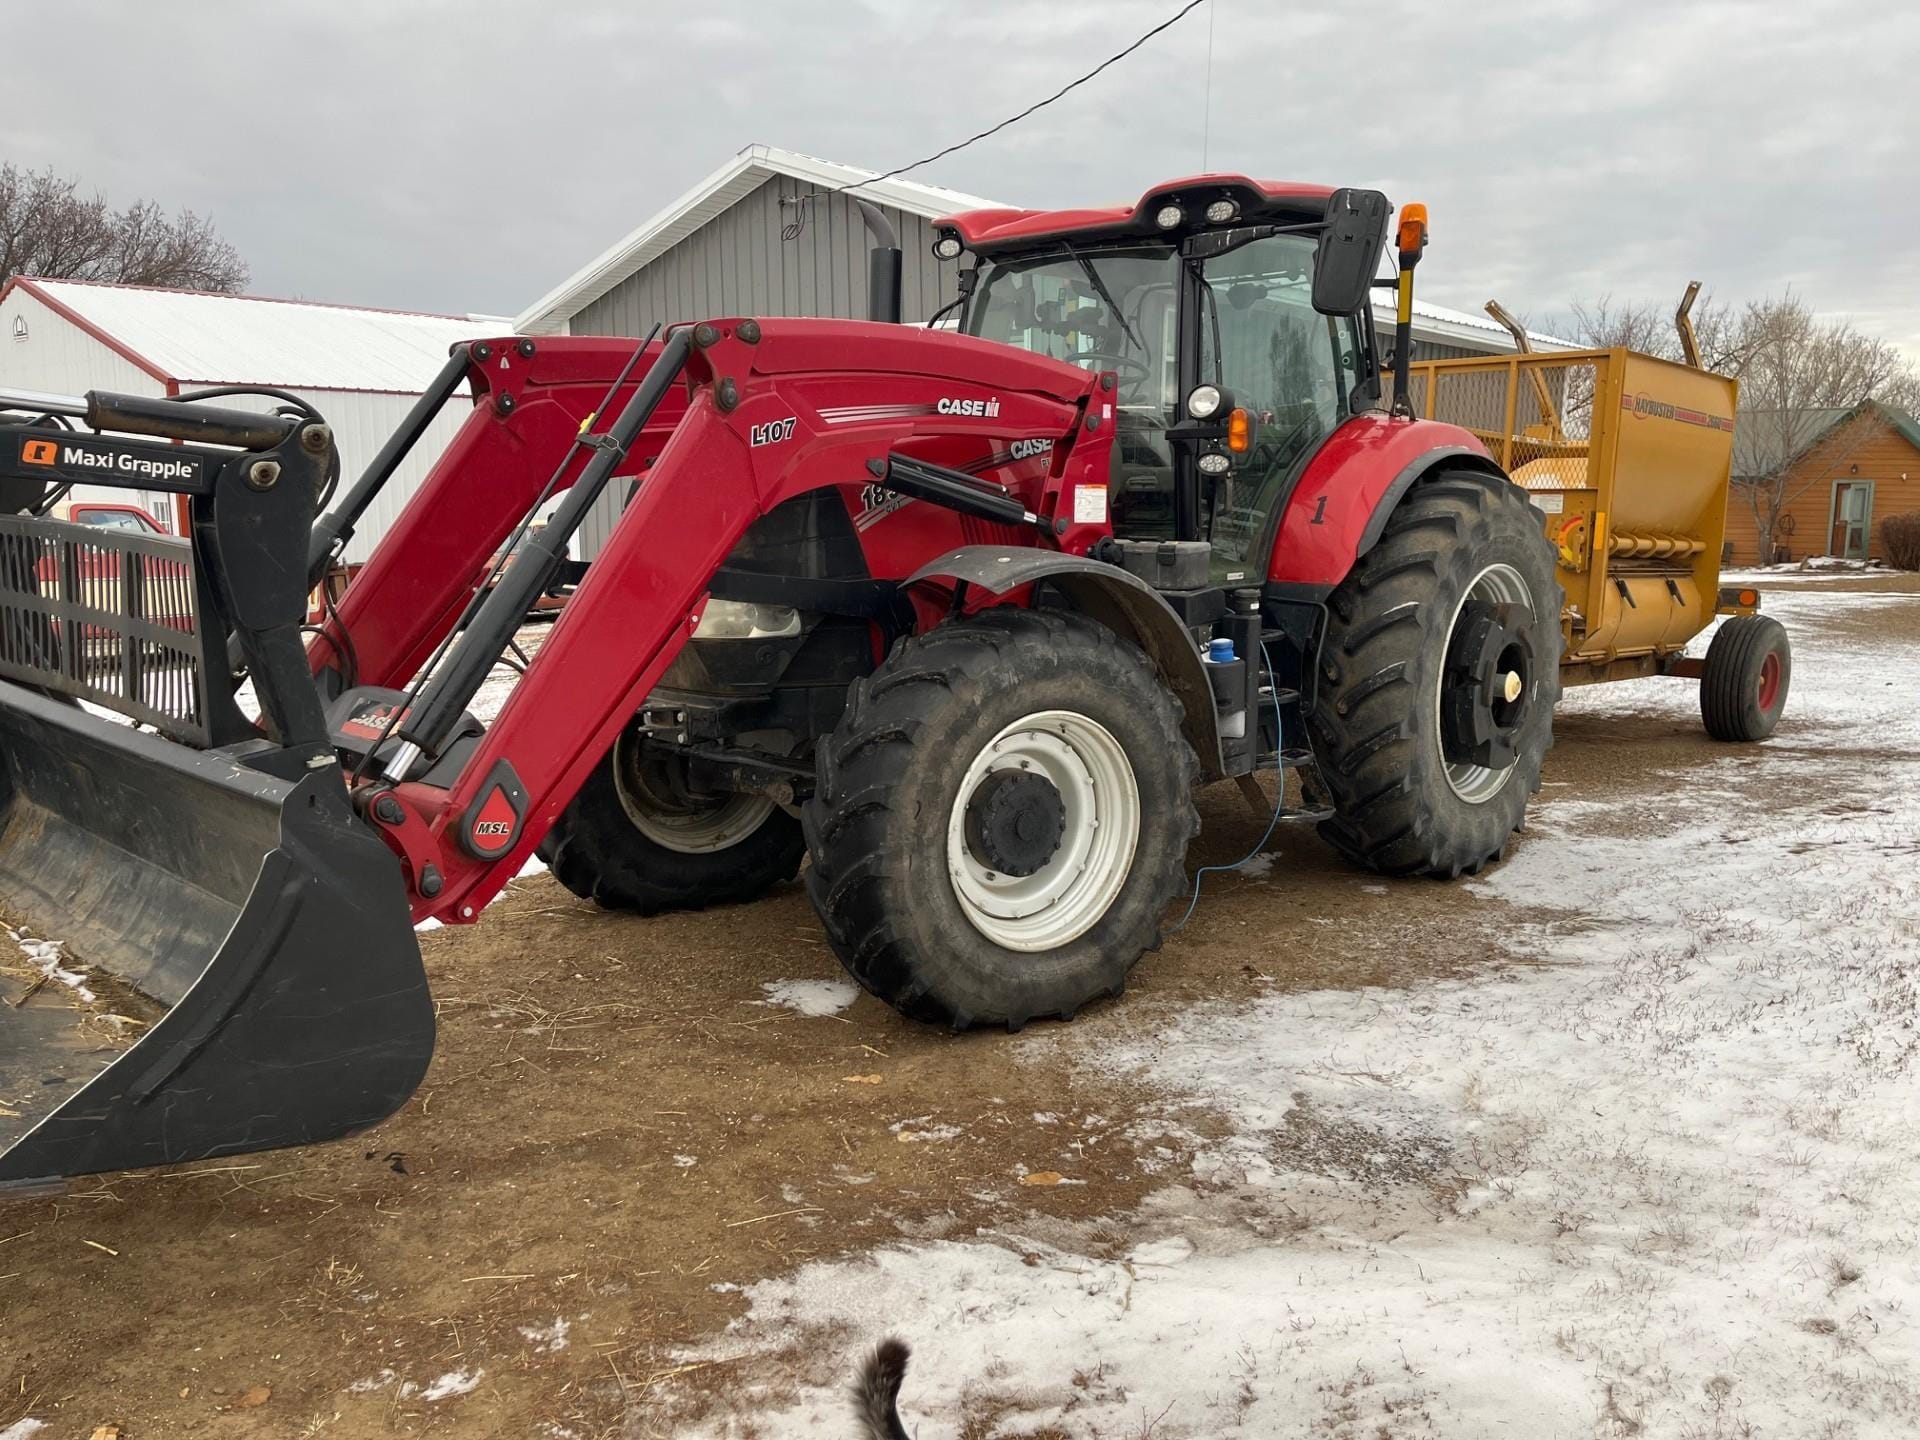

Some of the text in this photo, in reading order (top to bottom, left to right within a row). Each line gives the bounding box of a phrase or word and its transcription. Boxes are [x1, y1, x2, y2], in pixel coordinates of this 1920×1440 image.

[937, 397, 985, 417] CASE
[1634, 397, 1675, 420] HAYBUSTER
[751, 416, 797, 448] L107
[63, 447, 114, 469] Maxi
[1010, 438, 1052, 461] CASE
[1310, 495, 1328, 525] 1
[475, 821, 510, 835] MSL
